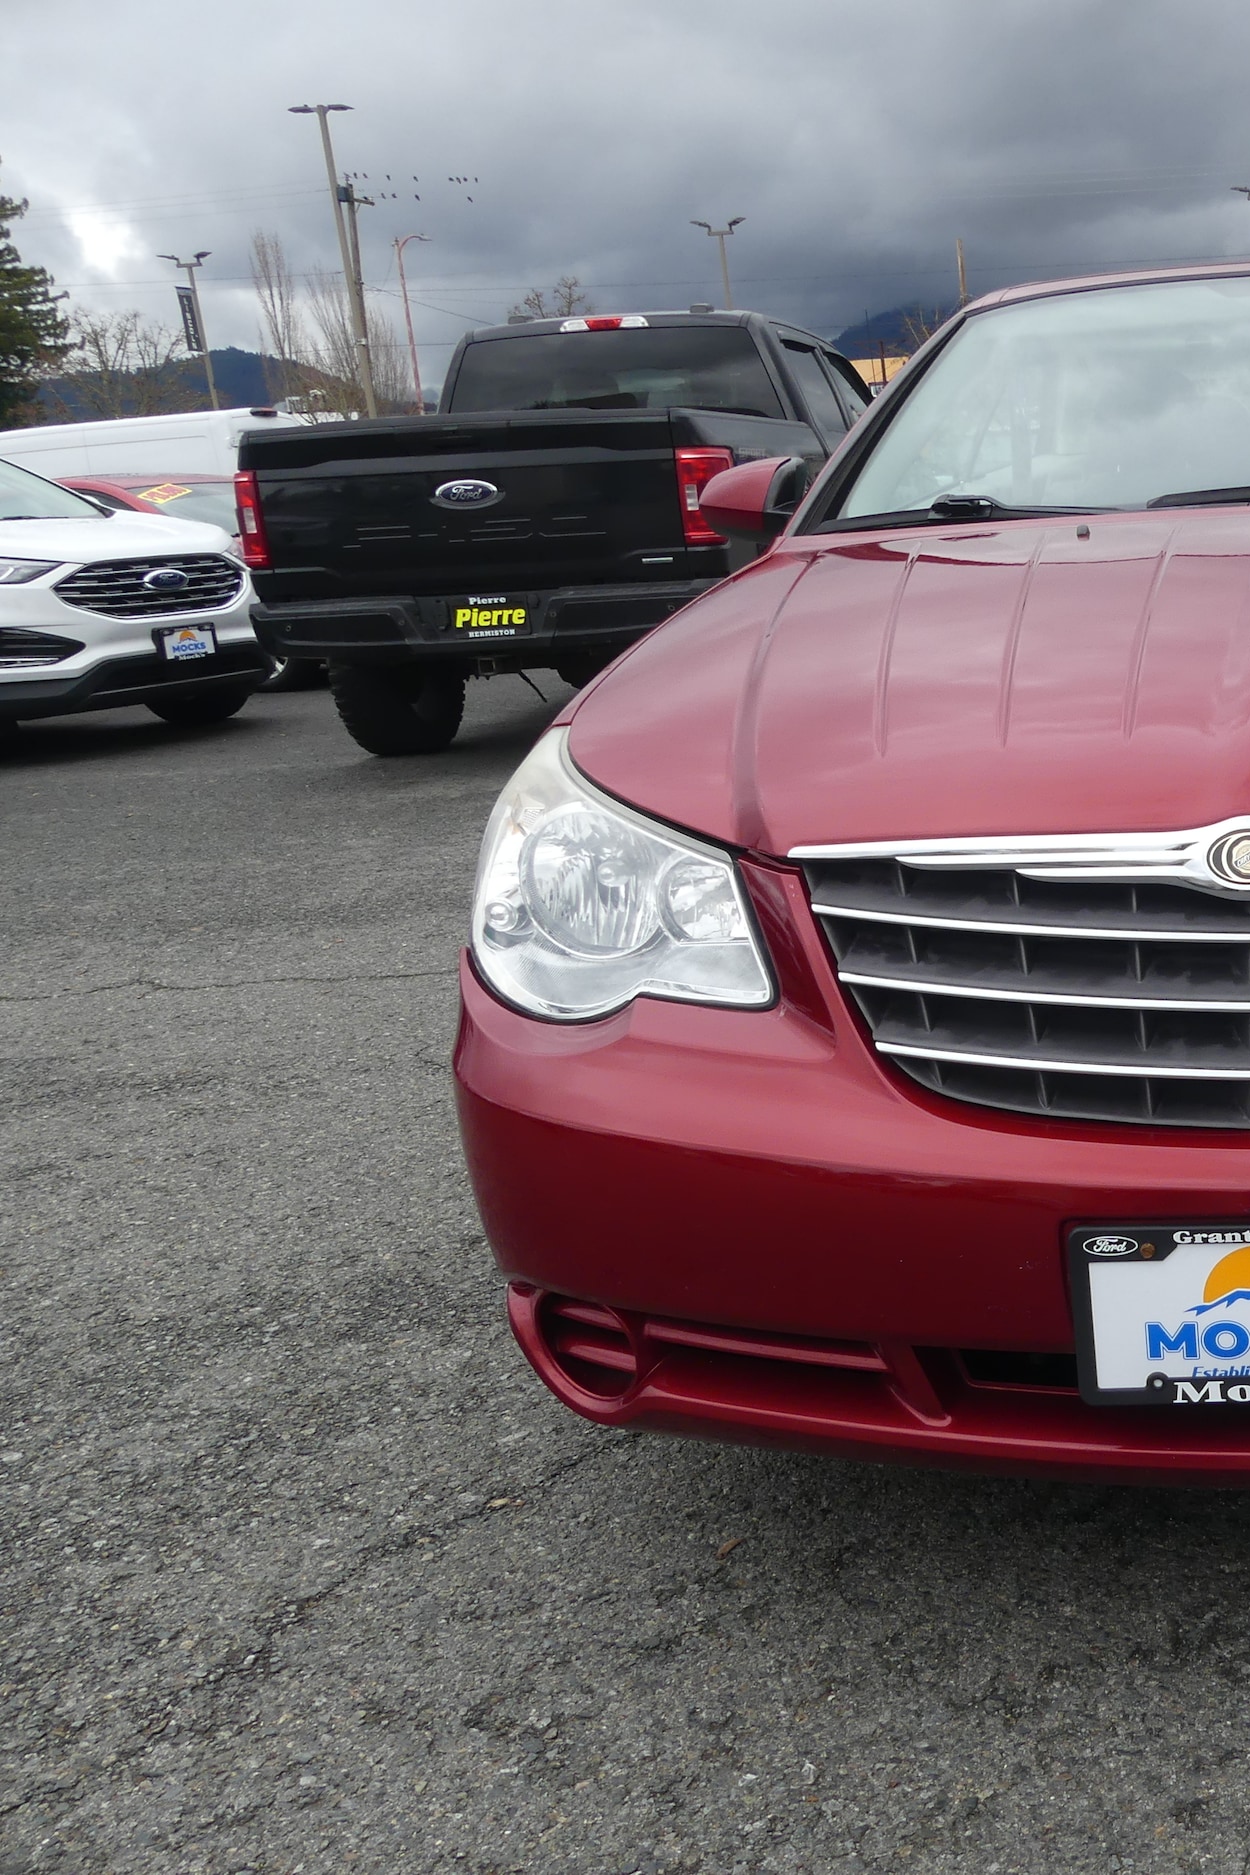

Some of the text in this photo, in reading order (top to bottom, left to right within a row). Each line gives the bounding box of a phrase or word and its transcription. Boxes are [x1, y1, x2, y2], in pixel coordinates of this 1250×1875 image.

[450, 486, 482, 500] Ford
[468, 596, 507, 605] Pierre
[456, 608, 526, 628] Pierre
[468, 629, 516, 638] HERMISTON
[172, 642, 206, 653] MOCKS
[1093, 1238, 1127, 1252] Ford
